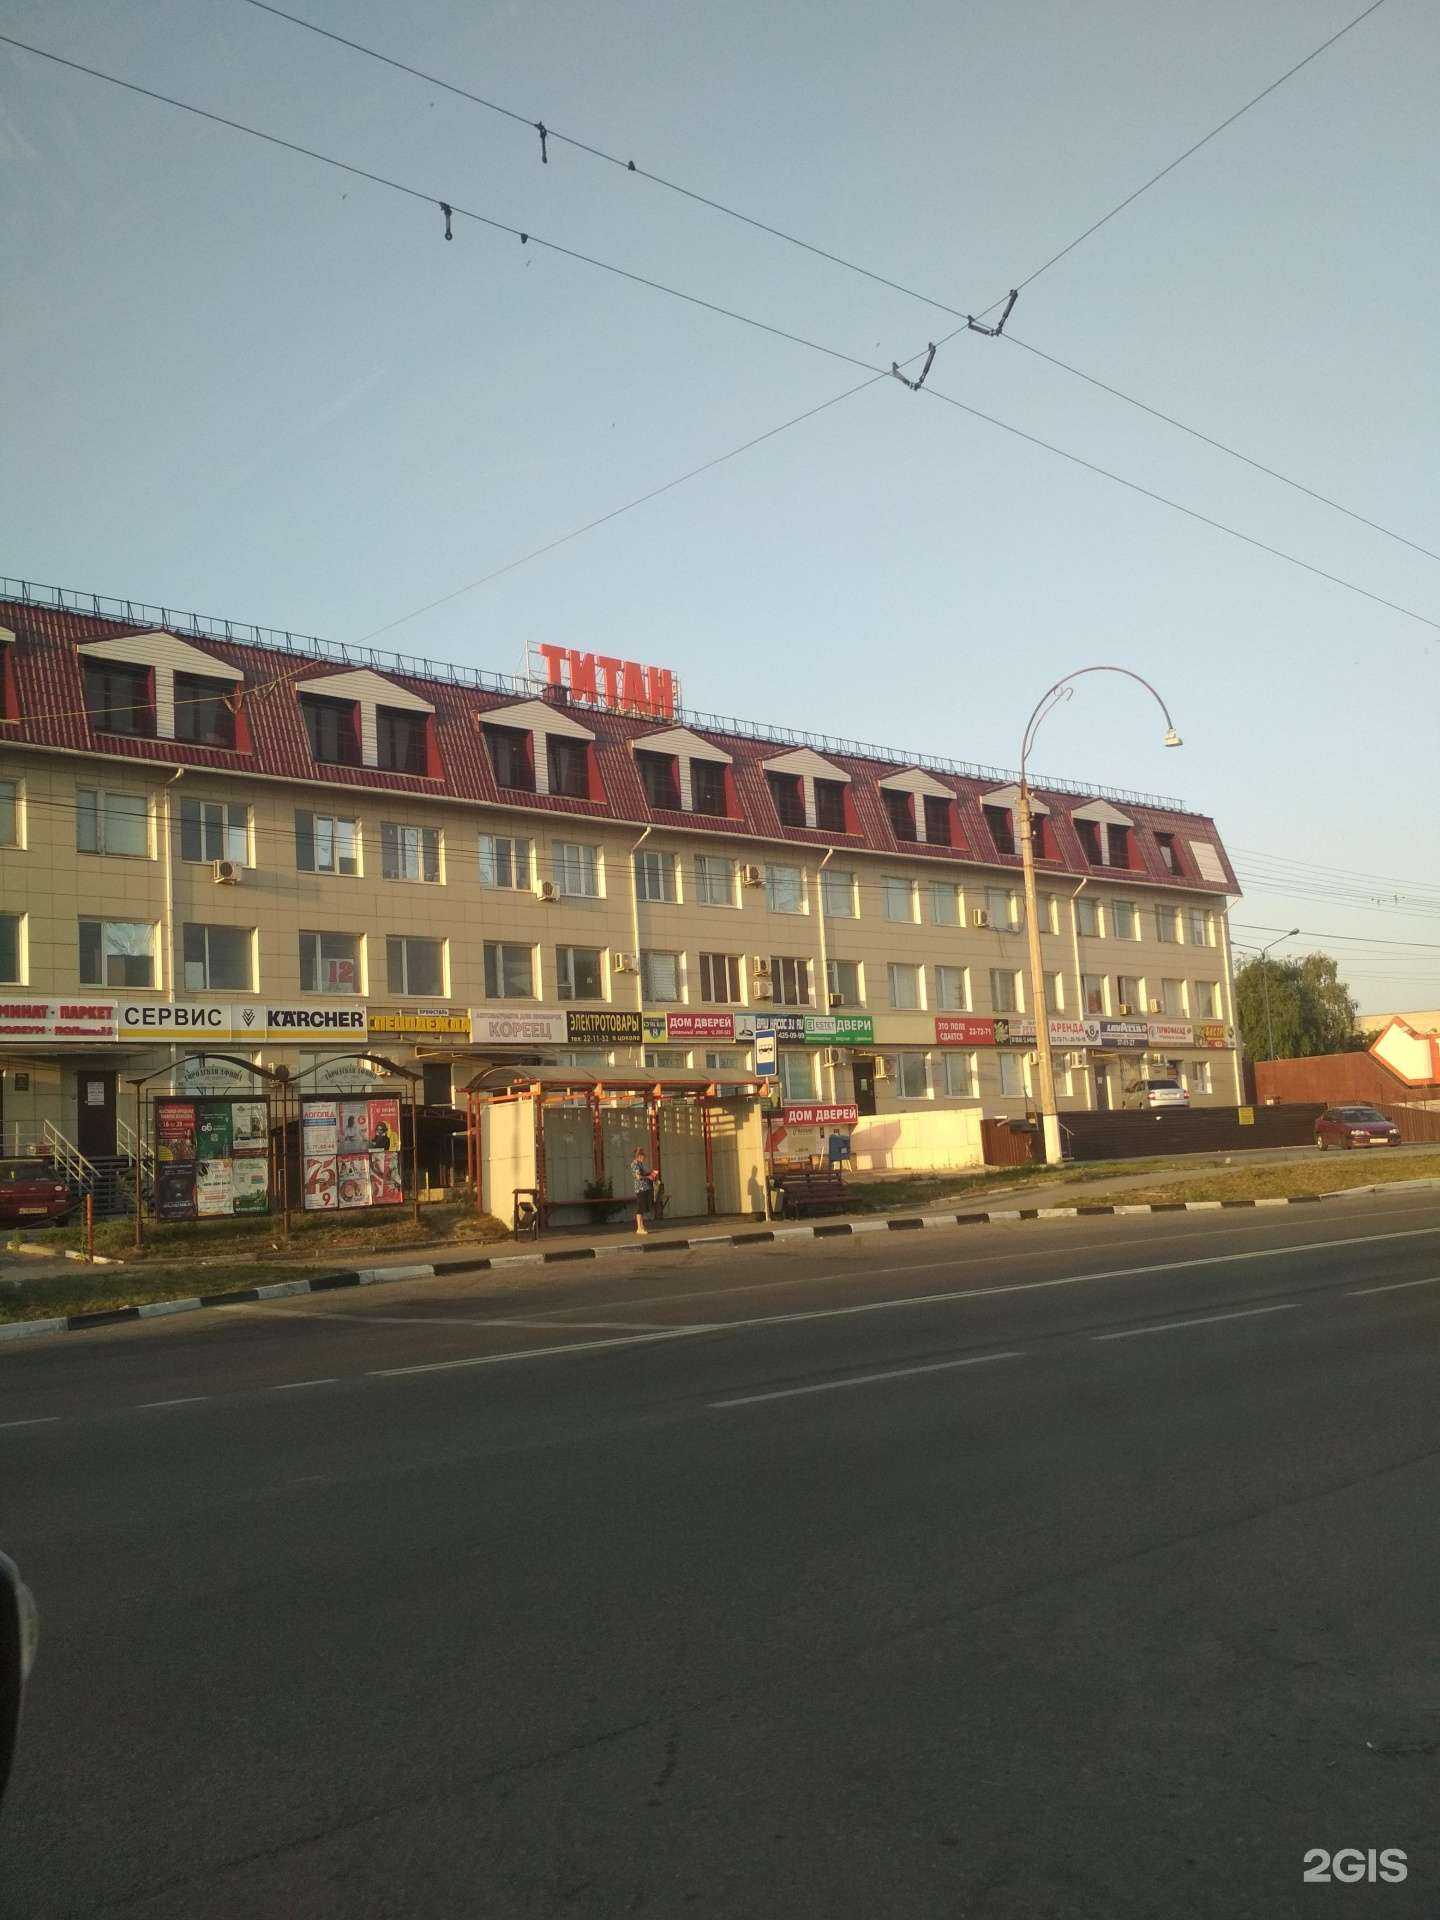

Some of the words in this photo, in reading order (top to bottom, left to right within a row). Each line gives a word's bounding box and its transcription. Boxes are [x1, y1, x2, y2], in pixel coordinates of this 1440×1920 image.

[540, 643, 673, 719] ТИТАН
[59, 1005, 113, 1020] ПАРКЕТ
[124, 1006, 223, 1027] СЕРВИС
[267, 1009, 364, 1029] KÄRCHER
[488, 1021, 552, 1040] КОРЕЕЦ
[570, 1014, 639, 1032] ЭЛЕКТРОТОВАРЫ
[670, 1017, 692, 1029] ДОМ
[694, 1015, 732, 1029] ДВЕРЕЙ
[836, 1019, 872, 1033] ДВЕРИ
[1050, 1022, 1084, 1034] АРЕНДА
[788, 1110, 813, 1123] ДОМ
[815, 1107, 857, 1122] ДВЕРЕЙ
